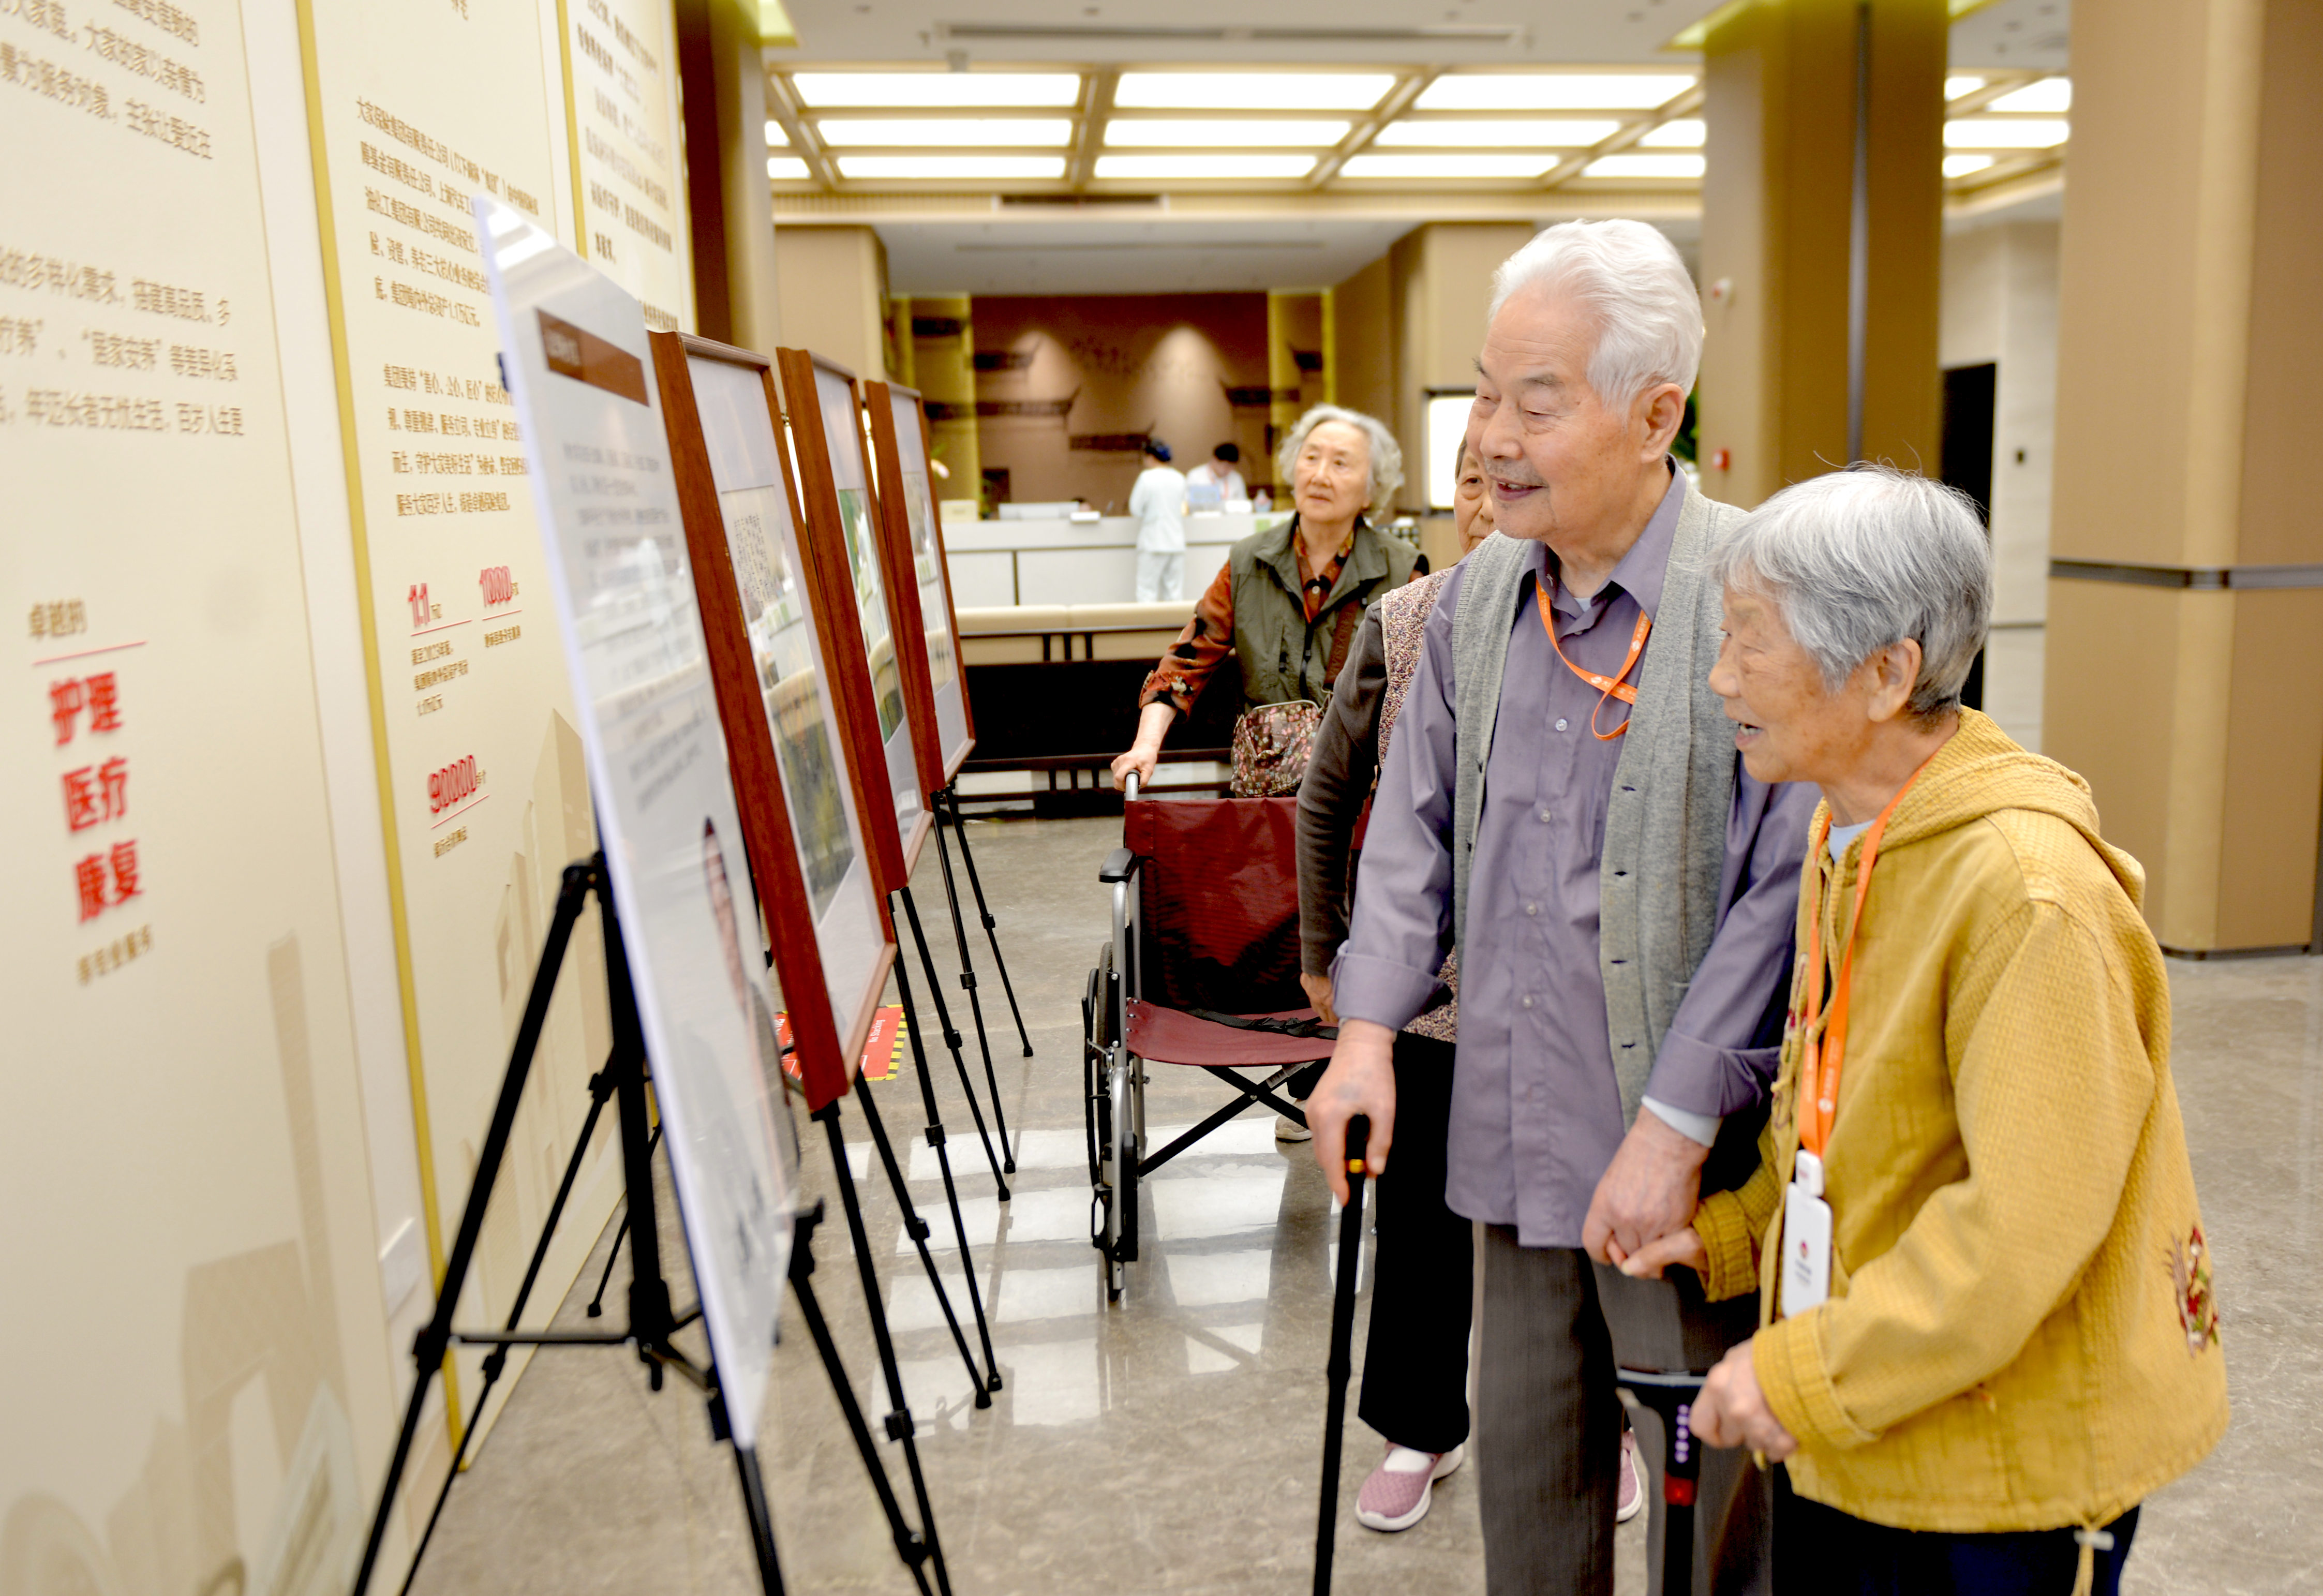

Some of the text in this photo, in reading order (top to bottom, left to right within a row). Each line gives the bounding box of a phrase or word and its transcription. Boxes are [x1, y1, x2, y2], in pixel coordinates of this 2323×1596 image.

[48, 671, 124, 747] 护理
[61, 756, 129, 834] 医疗
[74, 839, 144, 924] 康复
